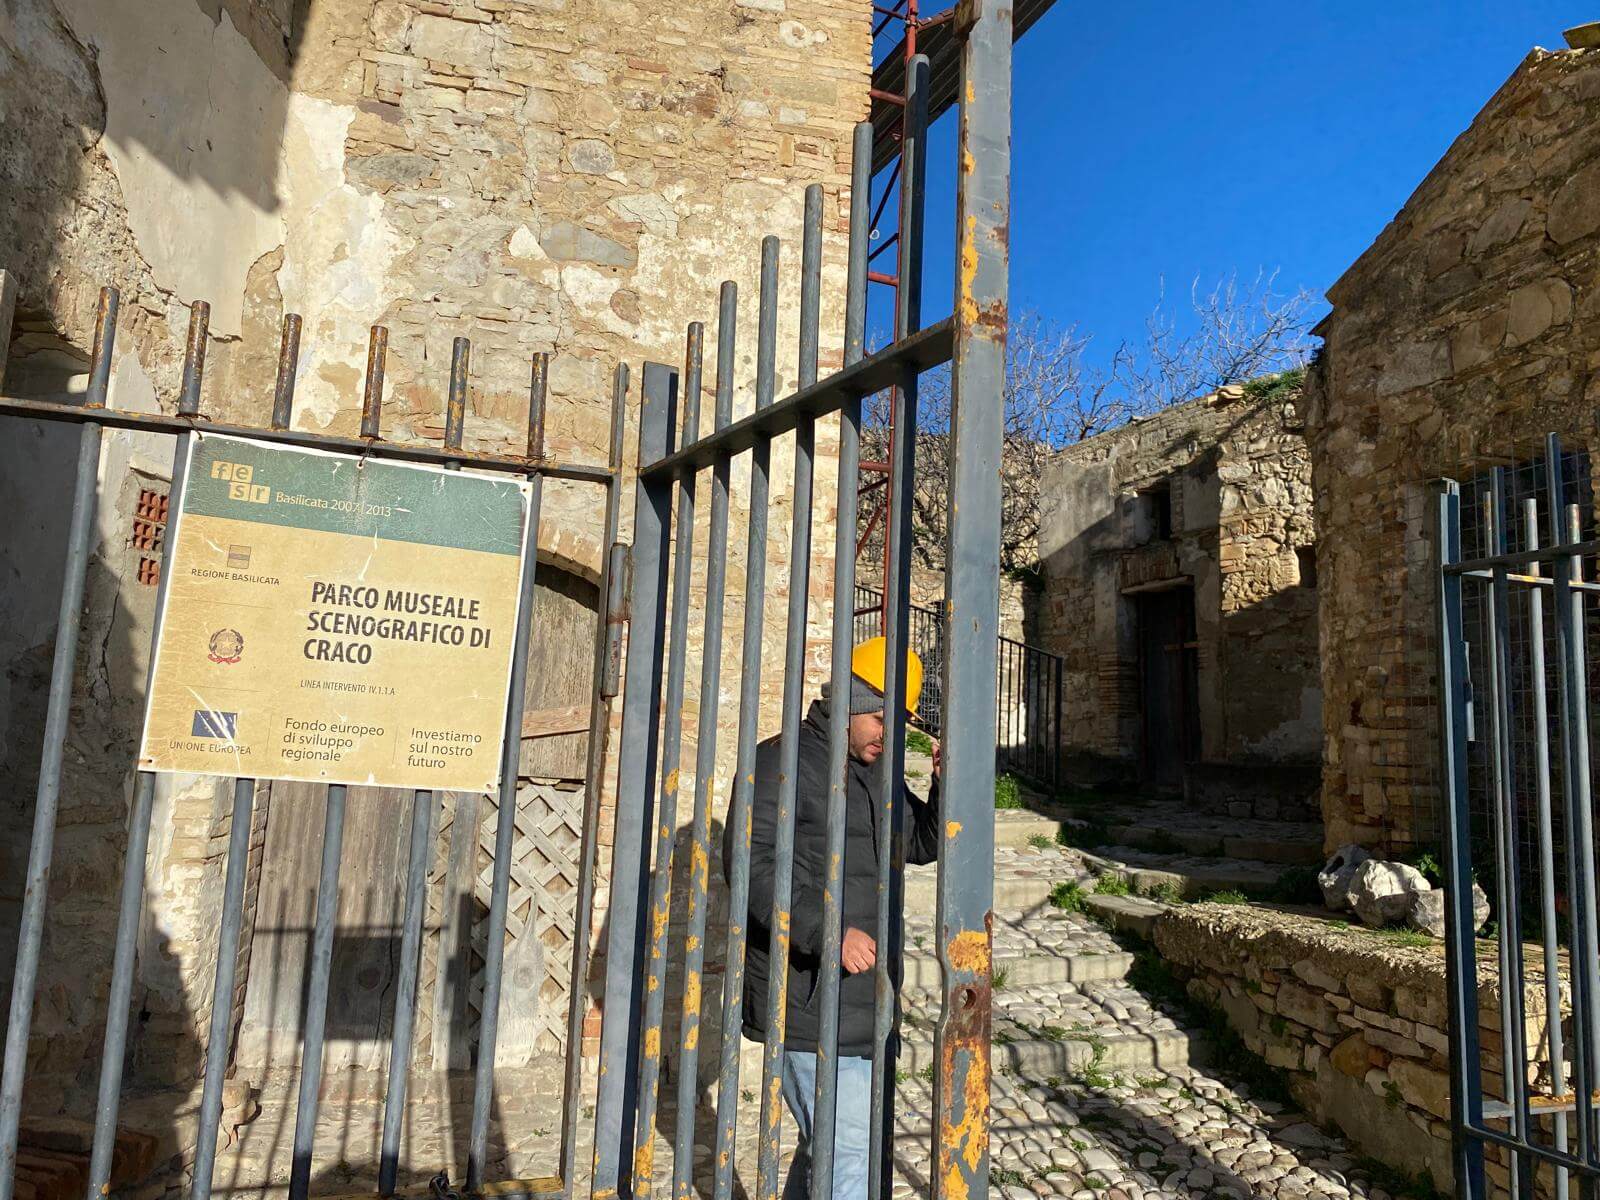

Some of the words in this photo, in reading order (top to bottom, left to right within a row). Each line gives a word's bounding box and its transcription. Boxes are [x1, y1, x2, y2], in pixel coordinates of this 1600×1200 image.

[276, 491, 328, 508] Basilicata
[191, 568, 230, 581] REGIONE
[231, 573, 280, 586] BASILICATA
[311, 581, 380, 610] PARCO
[383, 589, 481, 621] MUSEALE
[306, 611, 465, 646] SCENOGRAFICO
[469, 627, 491, 649] DI
[303, 638, 373, 665] CRACO
[300, 679, 322, 690] LINEA
[322, 680, 367, 694] INTERVENTO
[285, 717, 328, 733] Fondo
[330, 725, 385, 738] europeo
[411, 727, 483, 744] Investiamo
[169, 740, 206, 753] UNIONE
[283, 732, 296, 745] di
[299, 734, 354, 749] sviluppo
[281, 748, 342, 762] regionale
[409, 742, 428, 755] sul
[431, 744, 474, 757] nostro
[407, 755, 447, 769] futuro
